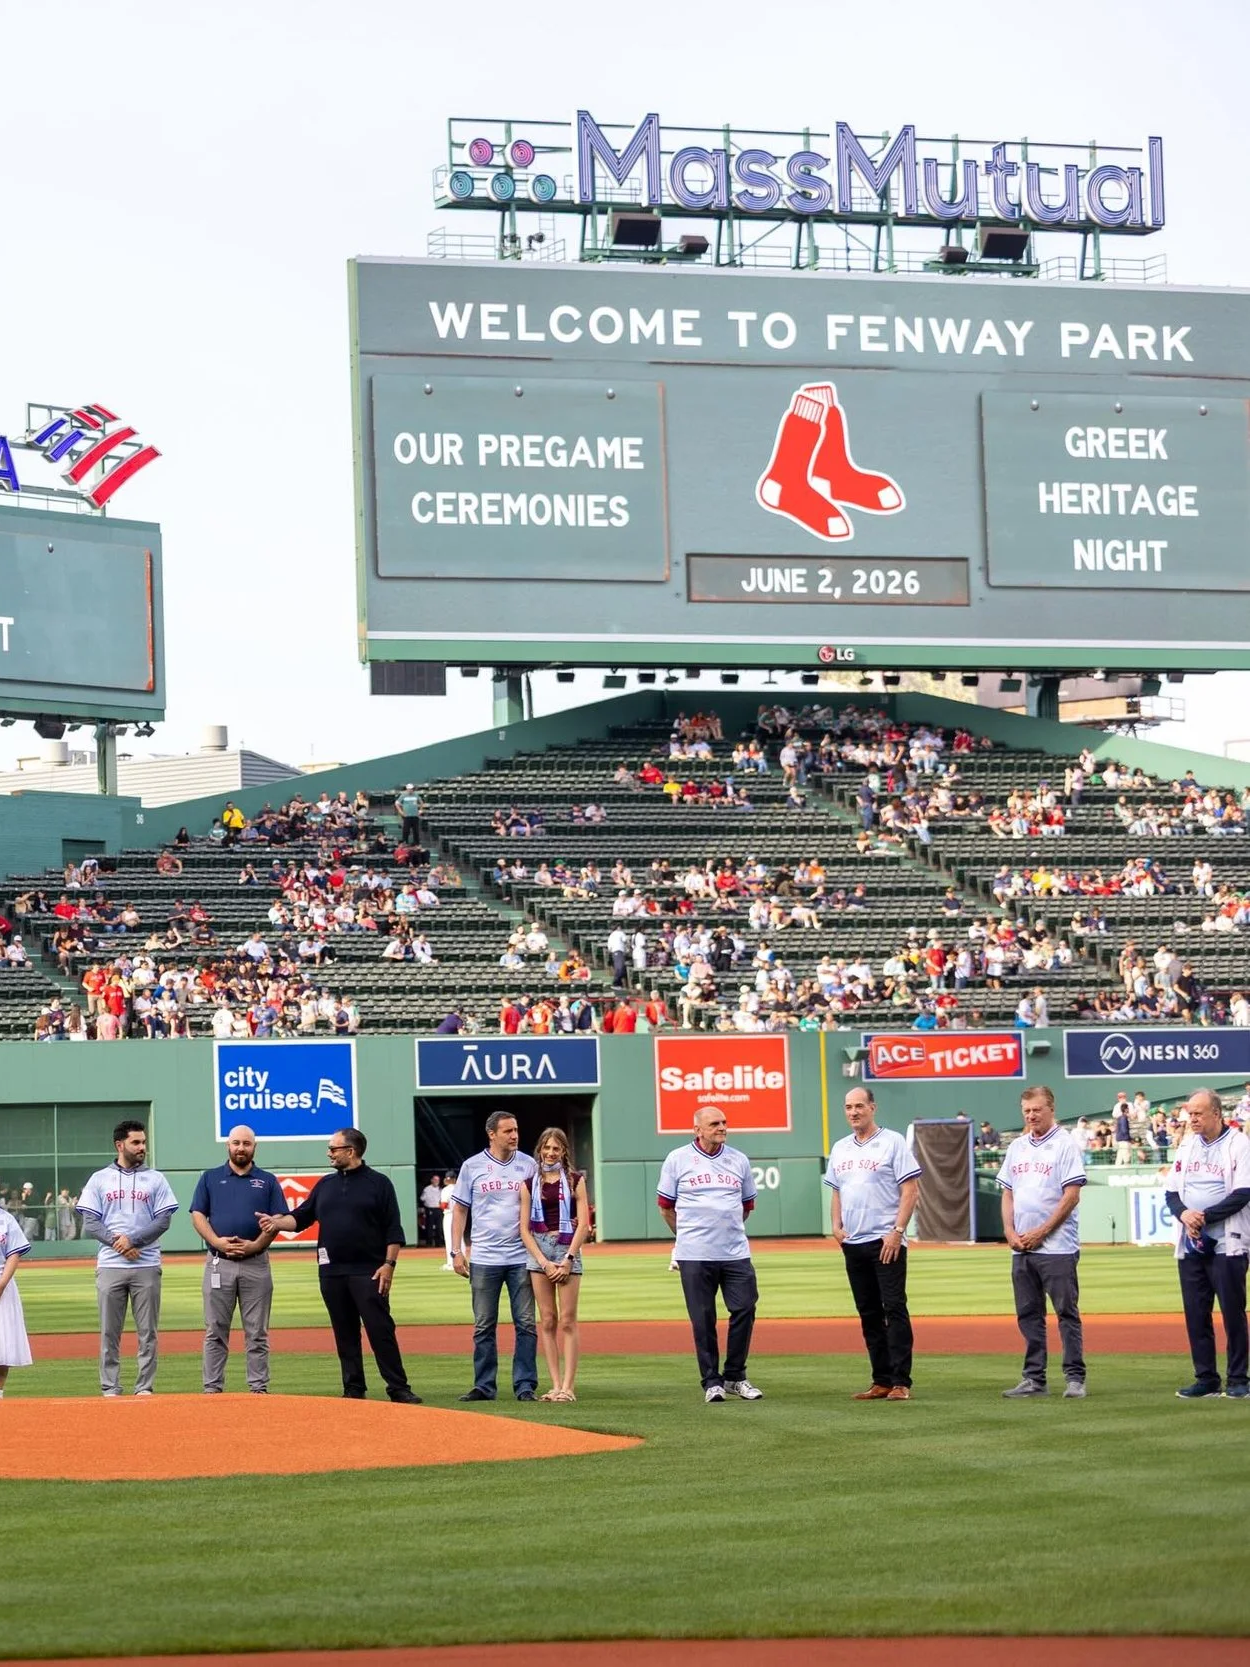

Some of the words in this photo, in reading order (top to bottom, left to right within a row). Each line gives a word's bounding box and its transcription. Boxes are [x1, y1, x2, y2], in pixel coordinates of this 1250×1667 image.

[576, 109, 1165, 228] MassMutual
[429, 301, 702, 347] WELCOME
[727, 311, 797, 350] TO
[827, 313, 1035, 357] FENWAY
[1060, 322, 1193, 362] PARK
[393, 432, 464, 466] OUR
[478, 433, 644, 469] PREGAME
[1064, 426, 1169, 460] GREEK
[411, 491, 630, 527] CEREMONIES
[1038, 481, 1200, 517] HERITAGE
[1073, 539, 1169, 572] NIGHT
[741, 567, 808, 593] JUNE
[817, 569, 842, 600] 2,
[852, 569, 921, 594] 2026
[836, 648, 855, 661] LG
[877, 1044, 925, 1066] ACE
[928, 1042, 1019, 1073] TICKET
[1139, 1044, 1190, 1061] NESN
[1192, 1044, 1220, 1060] 360
[224, 1066, 269, 1092] city
[660, 1065, 784, 1092] Safelite
[224, 1090, 313, 1110] cruises
[697, 1092, 751, 1103] safelite.com
[481, 1180, 502, 1193] RED
[507, 1181, 520, 1192] SO
[689, 1173, 711, 1187] RED
[717, 1174, 739, 1188] SOX
